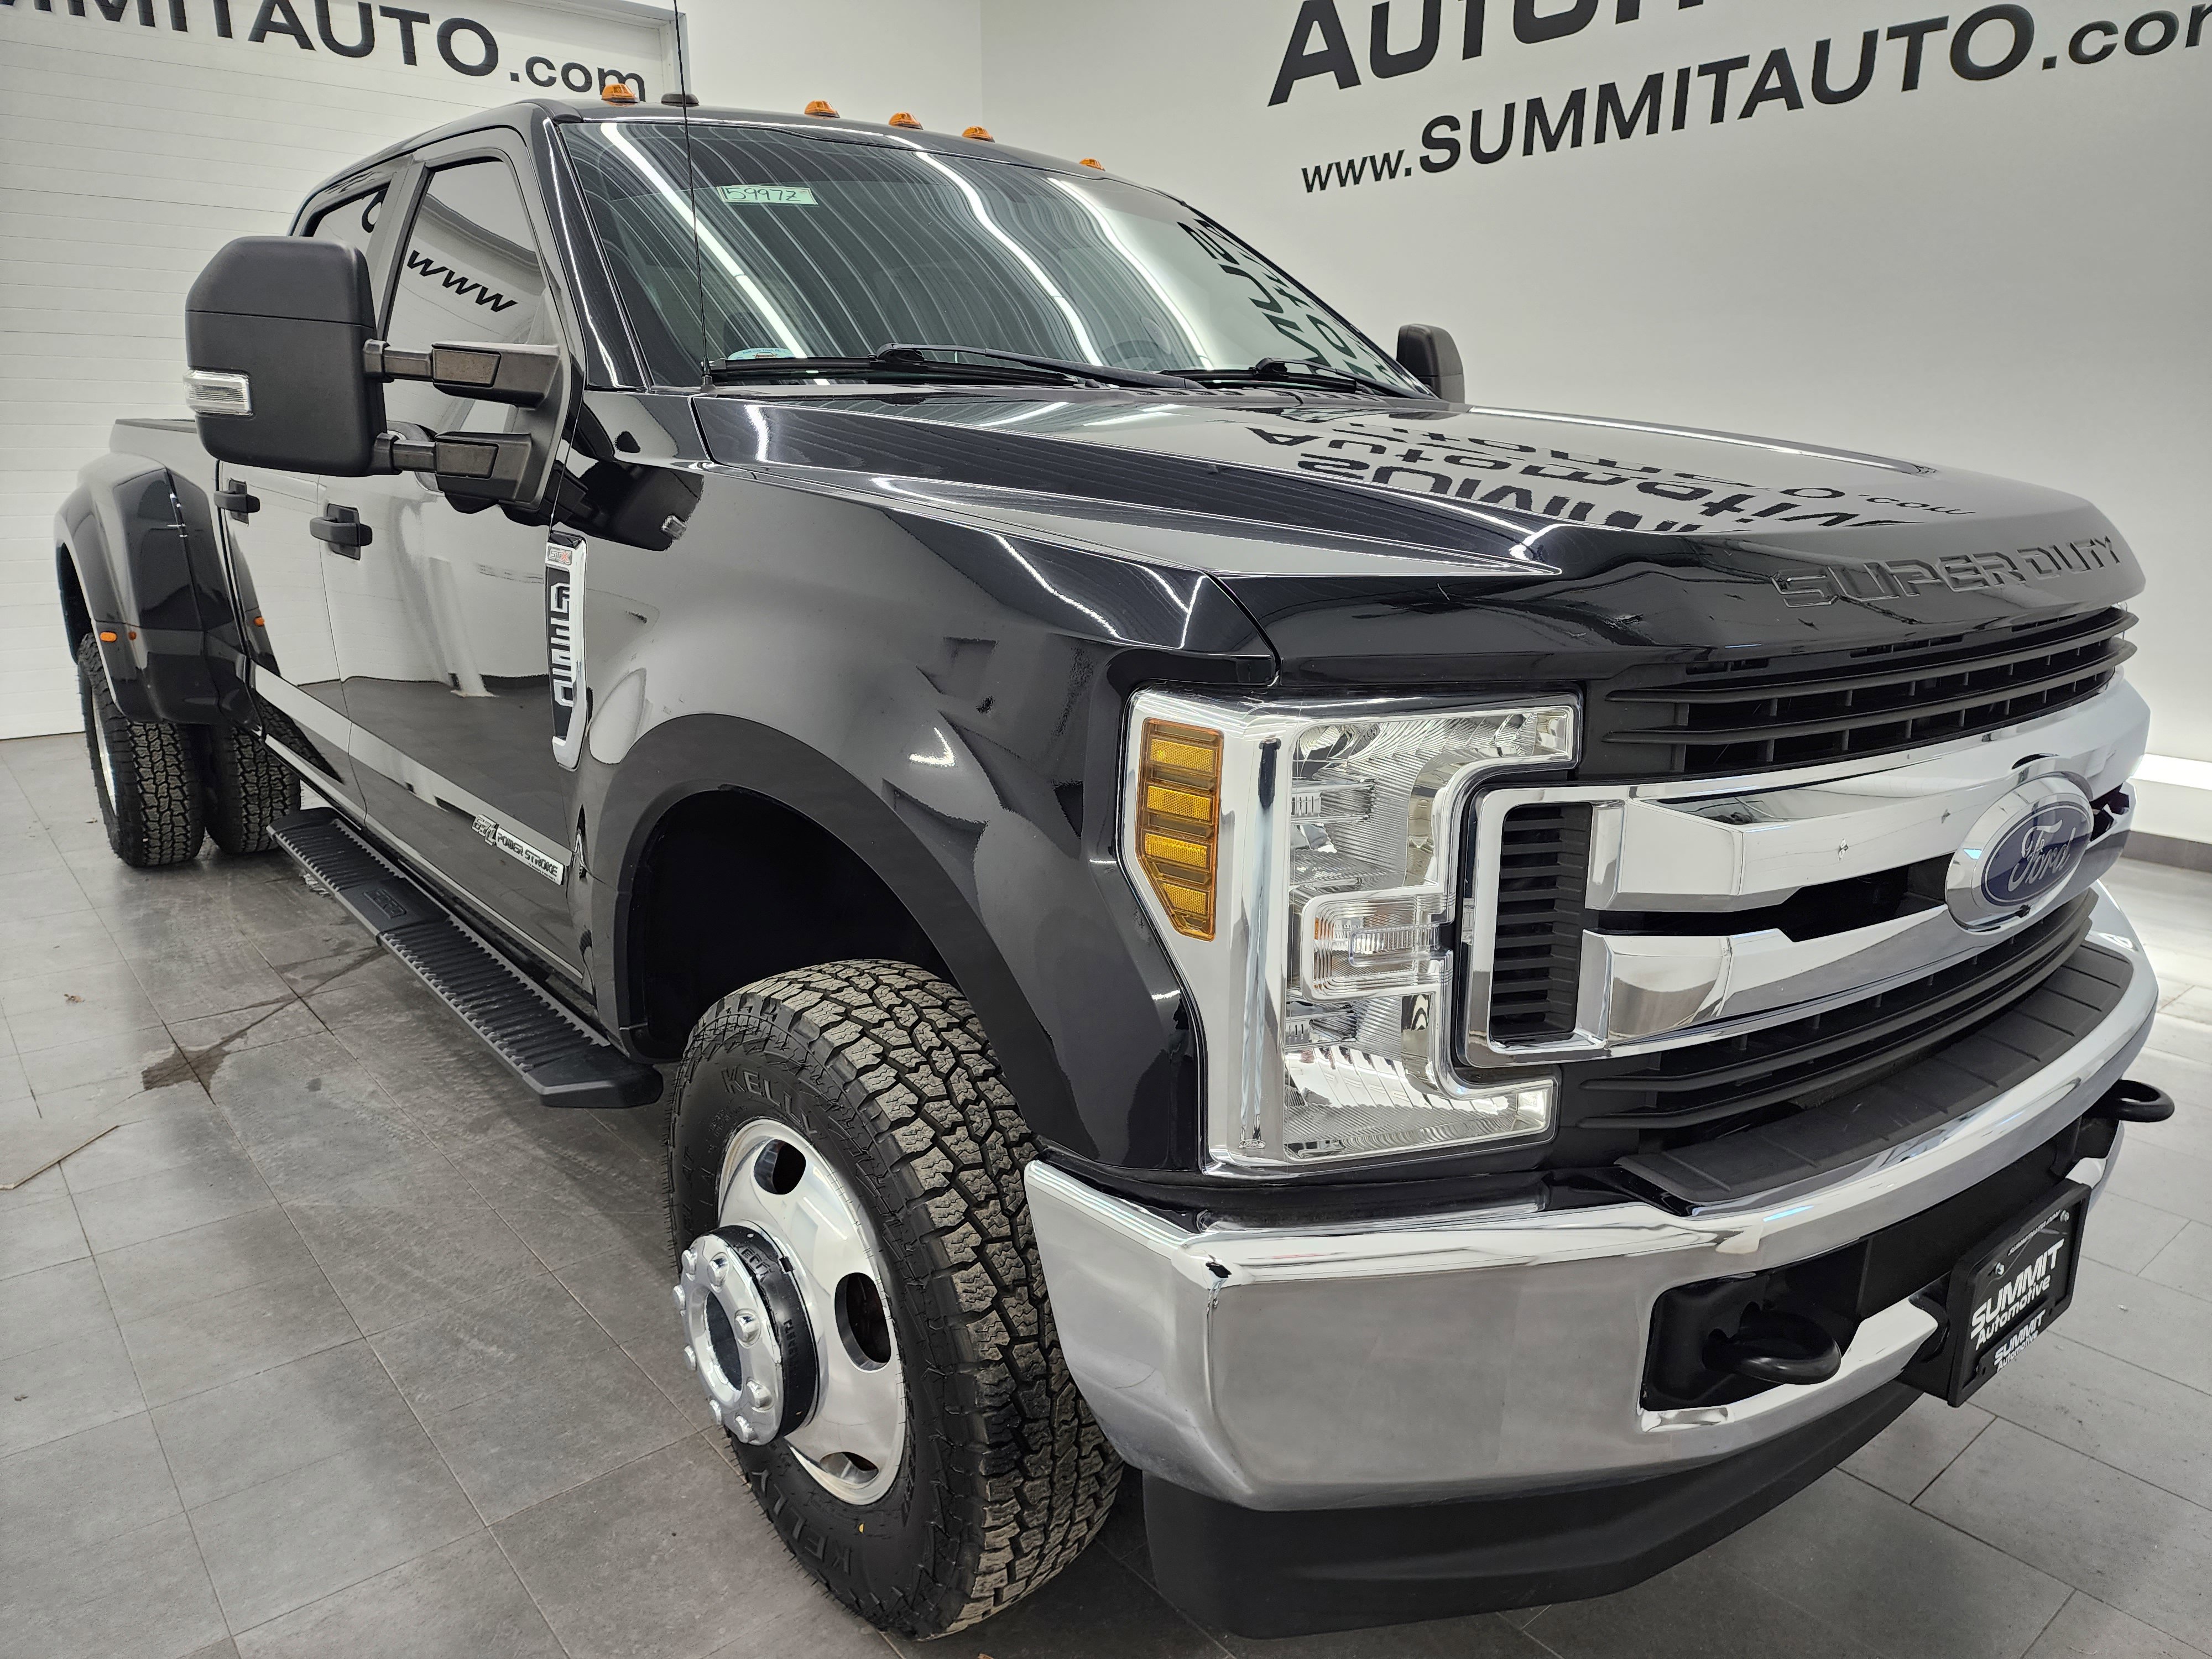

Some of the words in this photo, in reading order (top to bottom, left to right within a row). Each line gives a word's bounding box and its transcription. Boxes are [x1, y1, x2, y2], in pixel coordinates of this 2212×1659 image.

[549, 549, 571, 564] STX
[1771, 552, 2028, 608] SUPER
[2016, 535, 2121, 580] DUTY
[498, 832, 523, 857] POWER
[525, 849, 558, 878] STROKE
[2007, 819, 2076, 892] Ford
[721, 1066, 818, 1134] KELLY
[1970, 1238, 2065, 1340] SUMMIT
[1975, 1274, 2051, 1352] Automotive
[1994, 1309, 2046, 1366] SUMMIT
[1996, 1329, 2039, 1373] Automotive
[751, 1468, 851, 1576] KELLY
